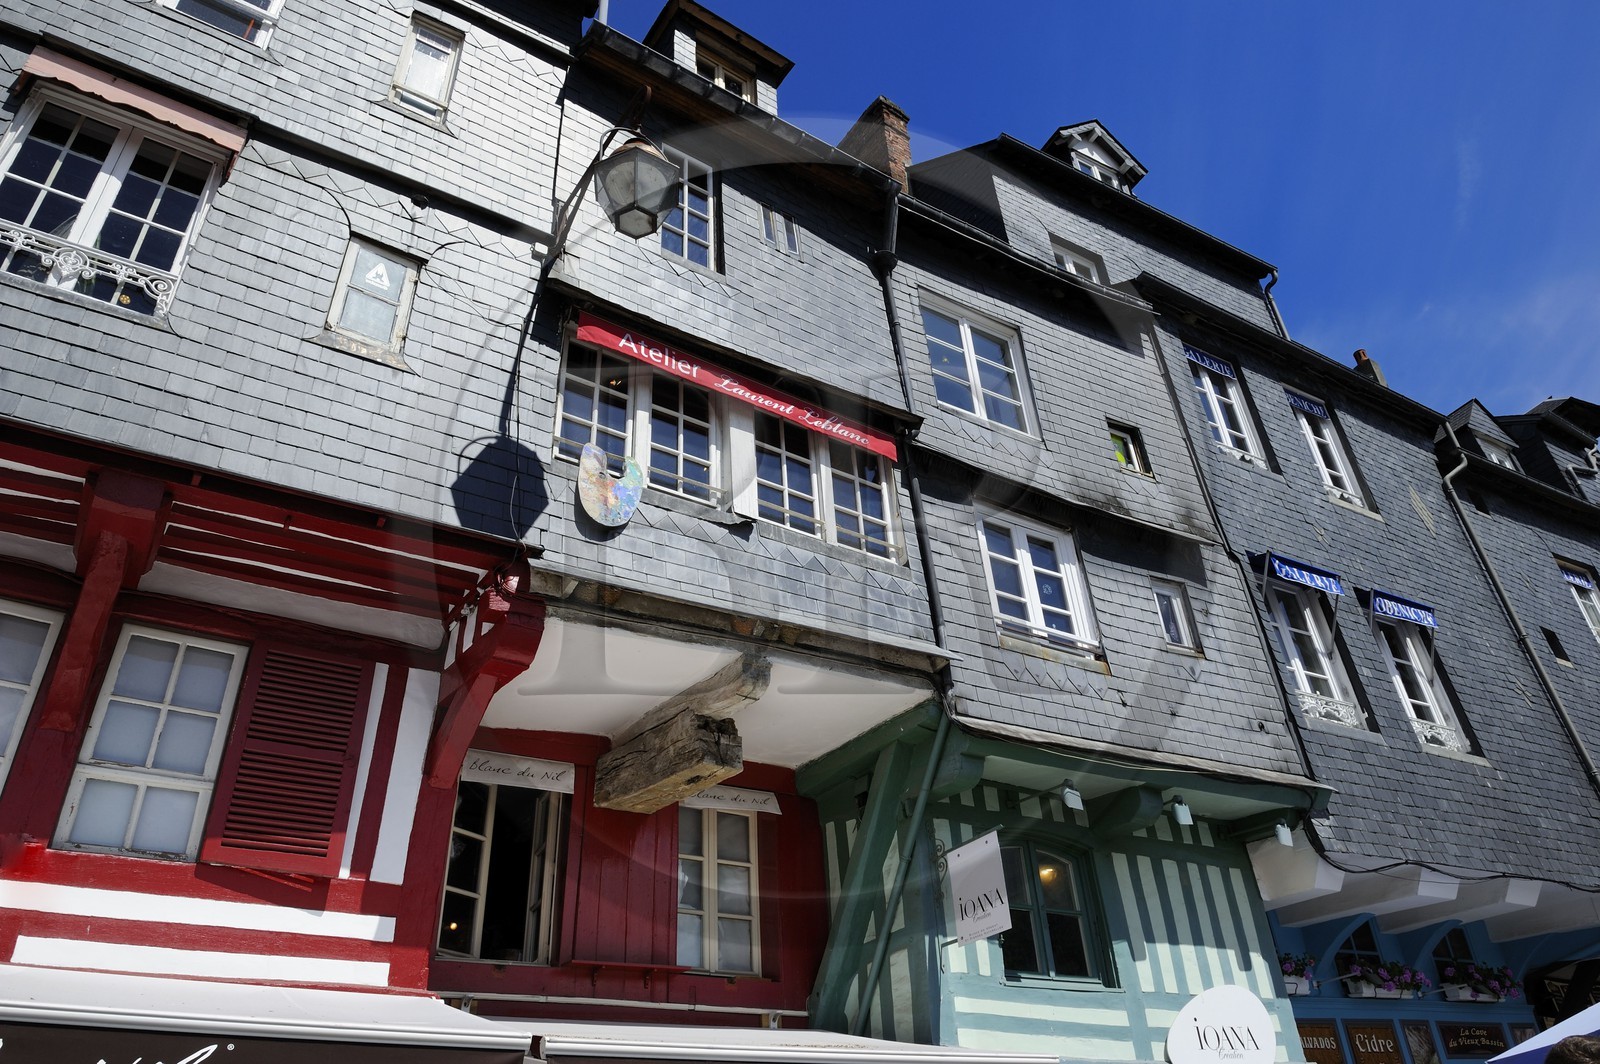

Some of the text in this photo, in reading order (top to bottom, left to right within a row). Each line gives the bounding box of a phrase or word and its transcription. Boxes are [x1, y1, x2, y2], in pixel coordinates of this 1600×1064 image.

[618, 333, 870, 445] Atelier Laurent Leblanc
[1285, 393, 1327, 418] BENICHE
[1275, 559, 1339, 592] GALERIE
[517, 766, 534, 778] du
[540, 770, 567, 781] Nil
[690, 789, 725, 801] lanc
[1460, 1027, 1487, 1036] La Cave
[1300, 1036, 1337, 1050] ALVADOS
[1355, 1033, 1394, 1053] Cidre
[1448, 1036, 1505, 1048] du Vieux Bassin
